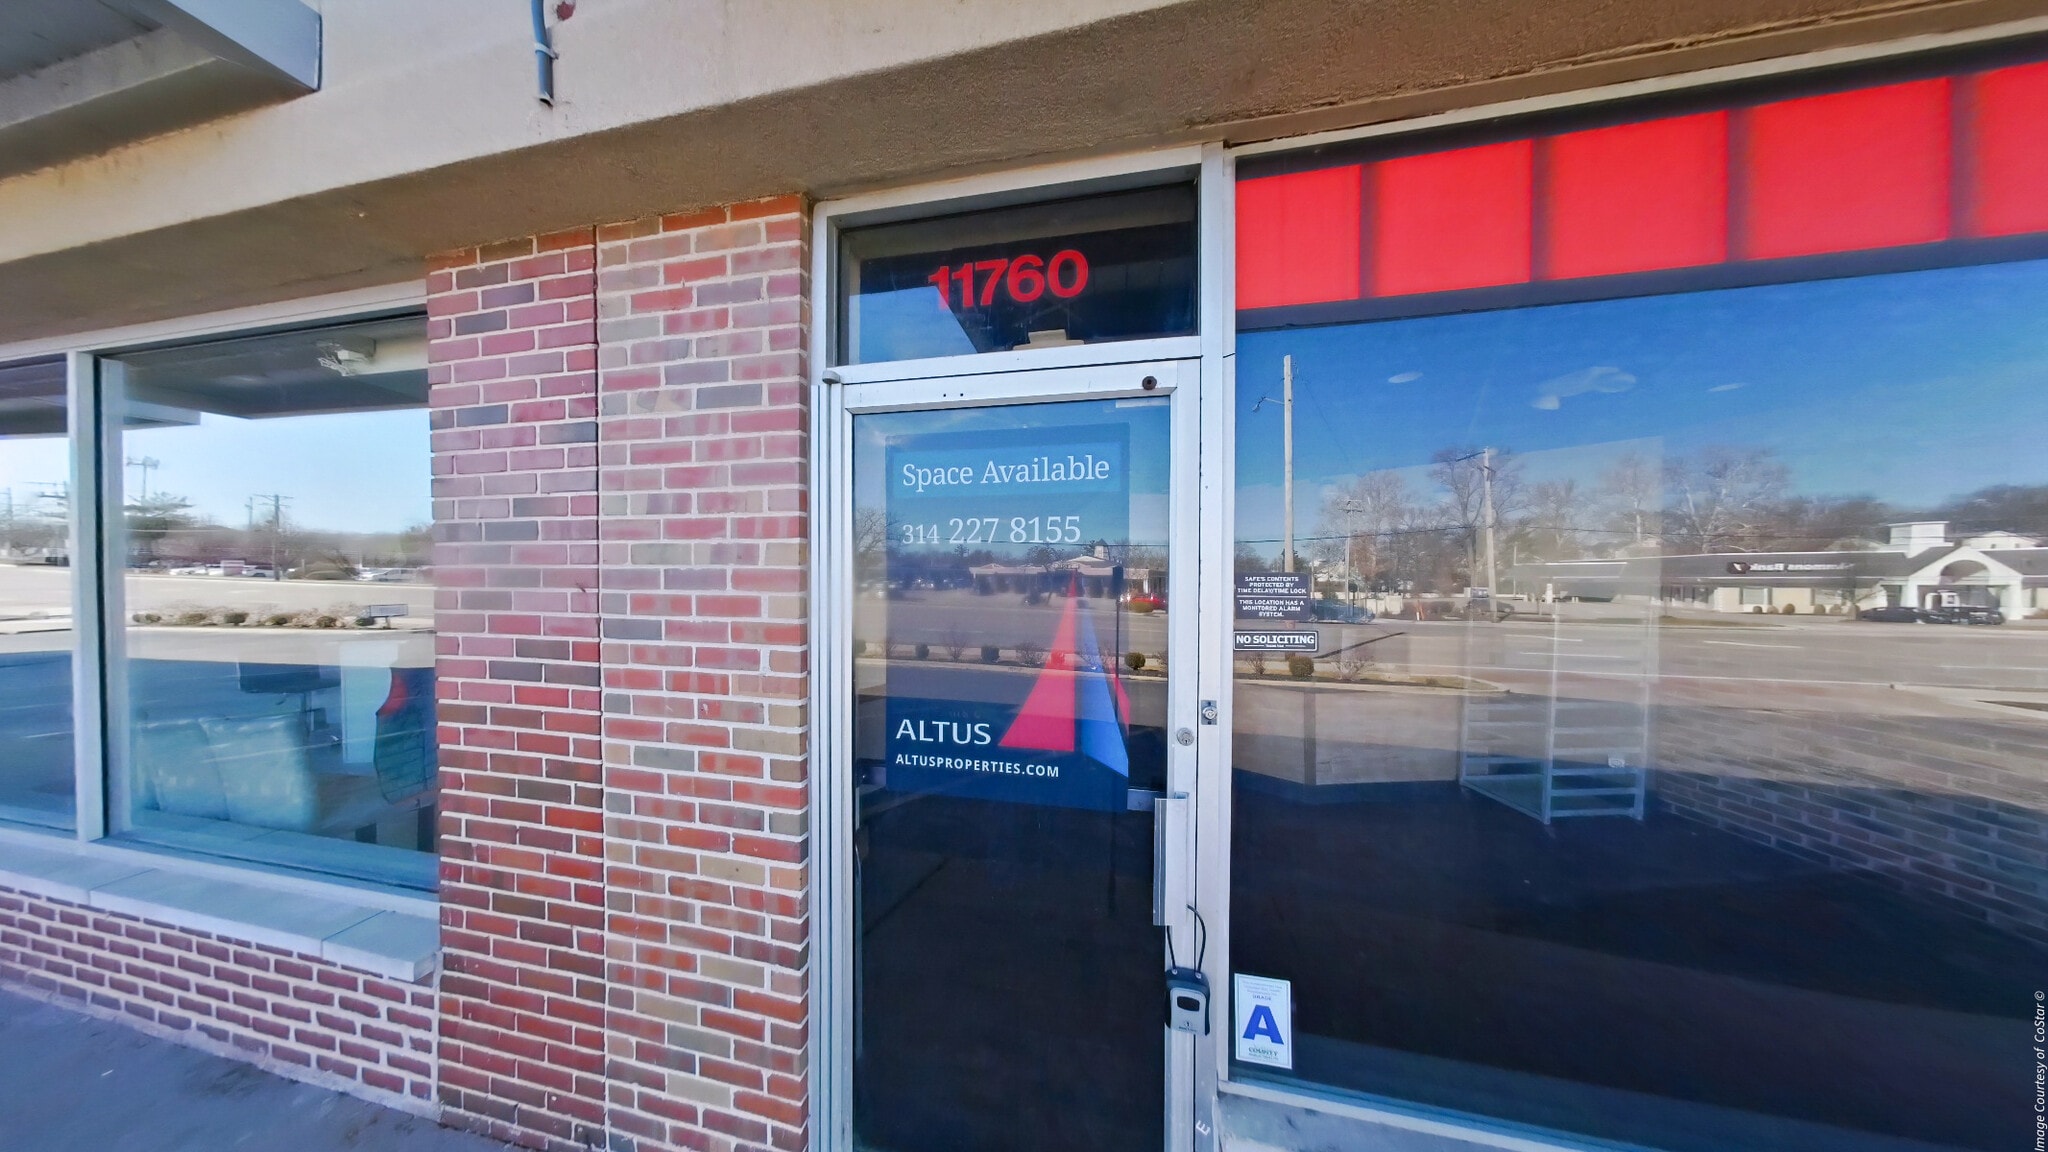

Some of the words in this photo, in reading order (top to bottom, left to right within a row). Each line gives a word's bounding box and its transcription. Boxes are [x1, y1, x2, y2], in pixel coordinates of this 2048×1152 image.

[928, 249, 1089, 310] 11760
[902, 463, 974, 492] Space
[980, 454, 1110, 484] Available
[902, 524, 939, 545] 314
[949, 518, 999, 544] 227
[1009, 516, 1081, 543] 8155
[1236, 635, 1251, 644] NO
[1253, 635, 1315, 644] SOLICITING
[895, 719, 992, 746] ALTUS
[895, 754, 1060, 778] ALTUSPROPERTIES.COM
[1242, 1004, 1285, 1045] A
